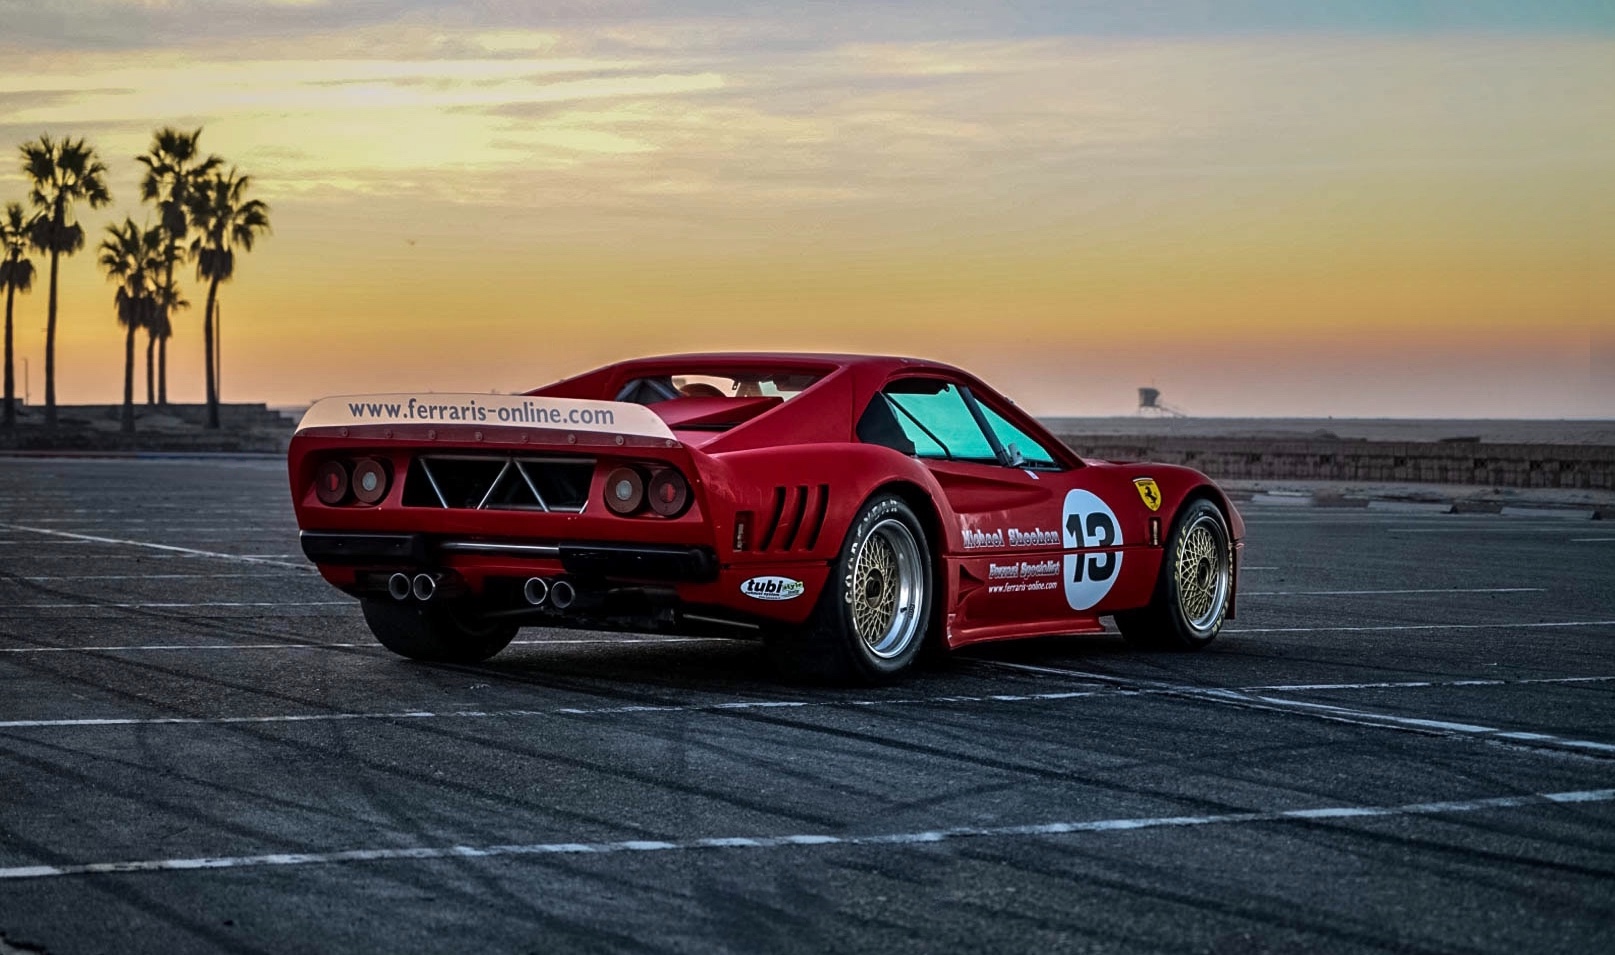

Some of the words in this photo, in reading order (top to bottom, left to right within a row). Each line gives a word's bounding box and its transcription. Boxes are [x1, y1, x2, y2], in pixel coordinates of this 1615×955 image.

[348, 398, 615, 425] www.ferraris-online.com
[961, 528, 1005, 548] Michael
[1008, 527, 1060, 547] Sheehan
[1066, 512, 1117, 583] 13
[988, 562, 1019, 579] Ferrari
[1020, 560, 1060, 580] Specialist
[747, 579, 784, 594] tubi
[988, 581, 1058, 593] www.ferraris-online.com
